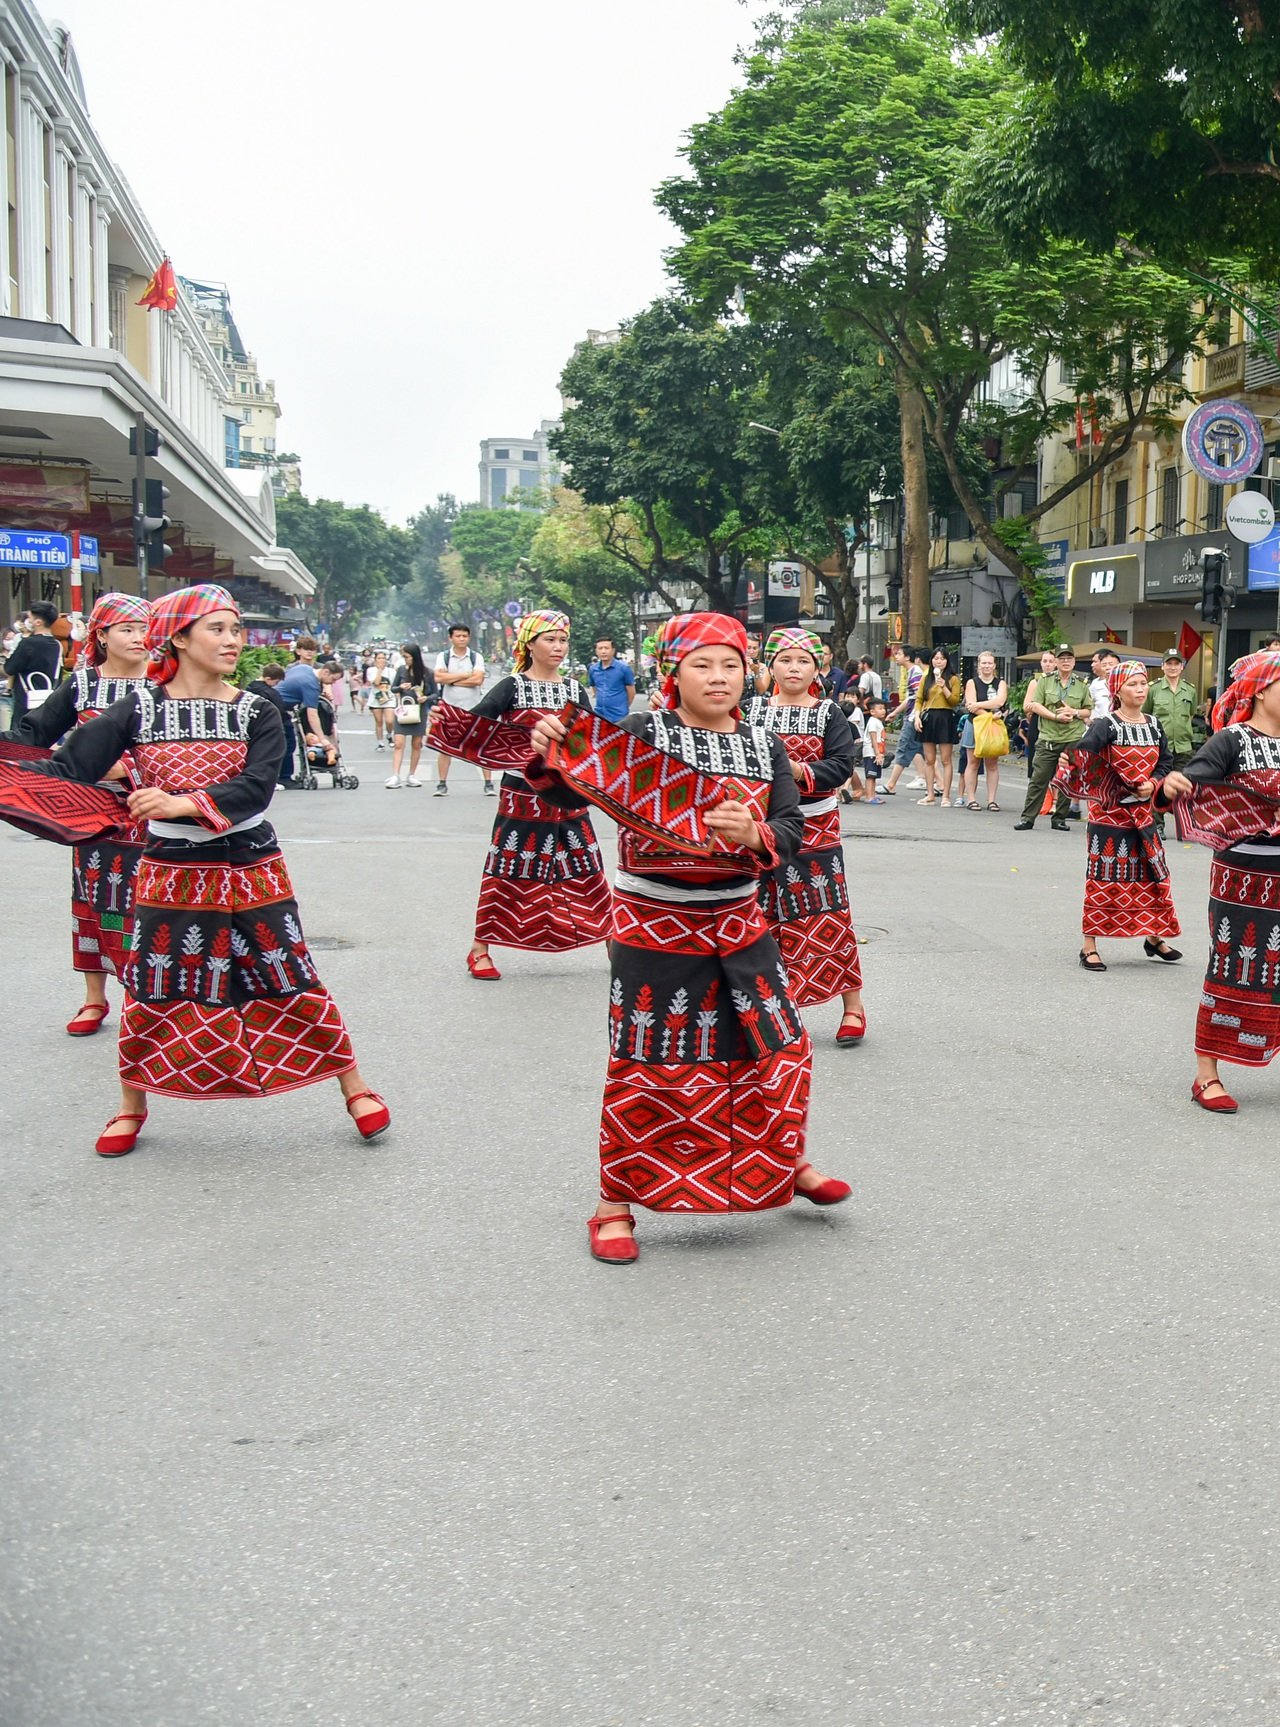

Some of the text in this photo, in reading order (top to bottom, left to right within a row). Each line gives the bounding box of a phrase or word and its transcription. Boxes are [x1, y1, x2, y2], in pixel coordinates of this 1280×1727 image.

[1229, 516, 1272, 526] Vietcombank
[26, 535, 51, 545] PHỐ
[0, 546, 66, 564] TRÀNG TIỀN
[1090, 570, 1115, 594] MLB
[1172, 573, 1203, 584] SHOPDUN
